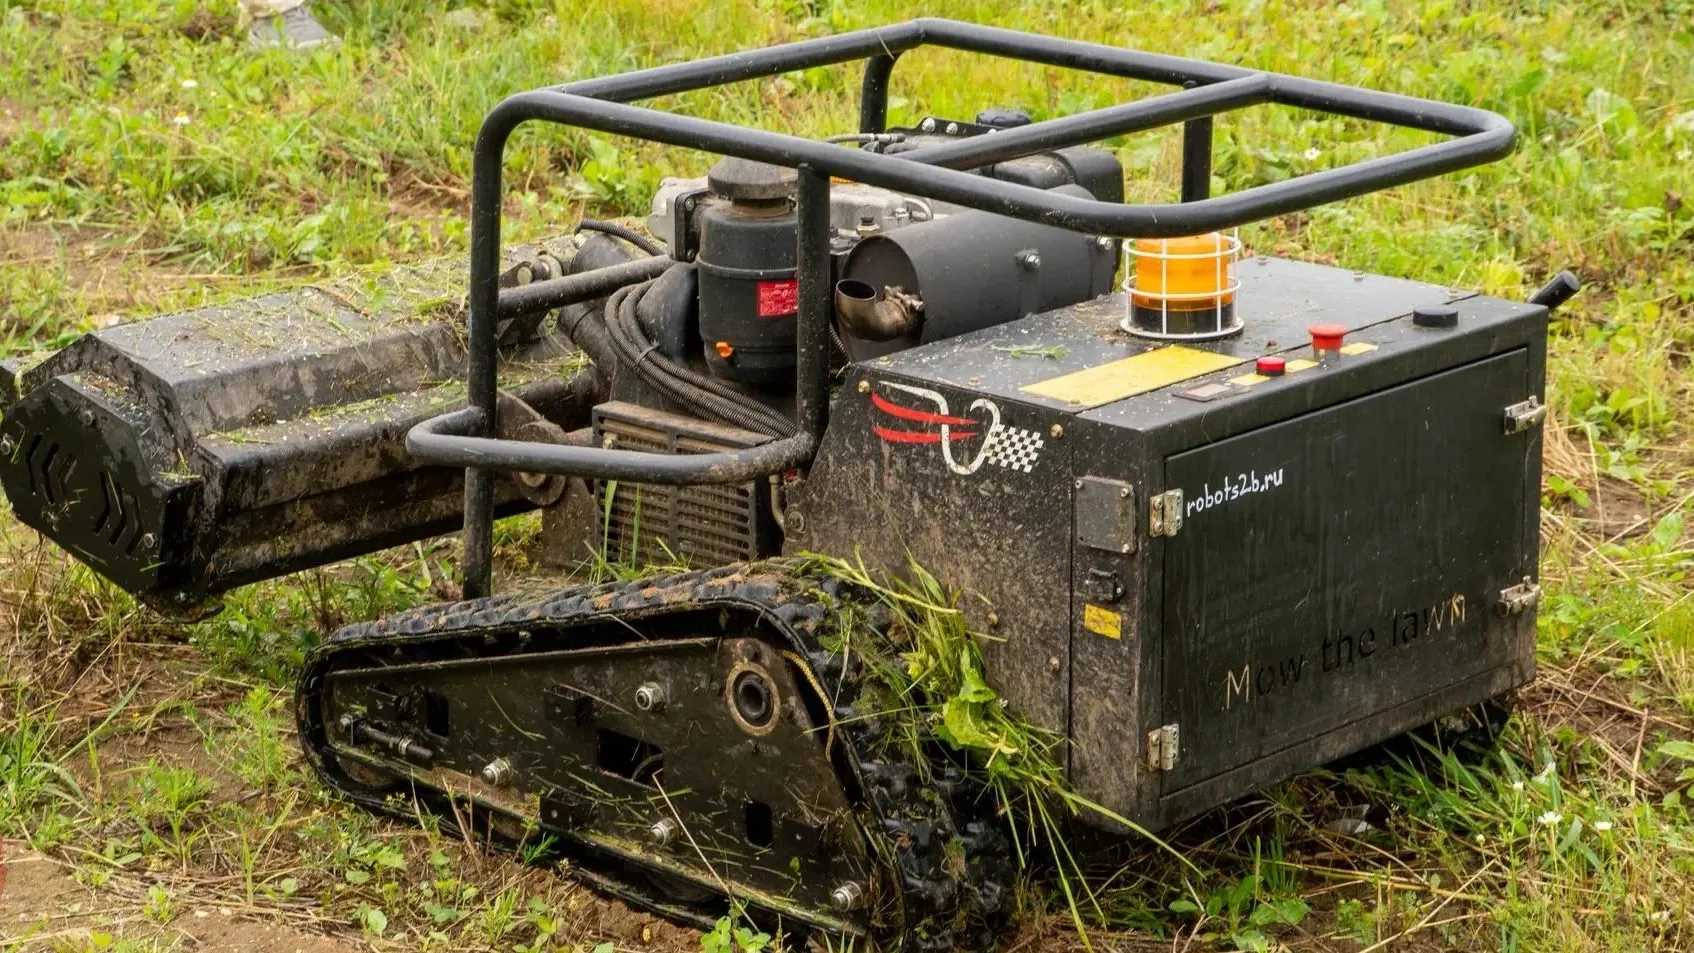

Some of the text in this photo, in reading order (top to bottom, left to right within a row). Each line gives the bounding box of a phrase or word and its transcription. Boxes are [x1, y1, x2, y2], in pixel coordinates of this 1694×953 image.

[1187, 468, 1284, 517] robots2b.ru
[1226, 593, 1466, 710] Mow the lawn
